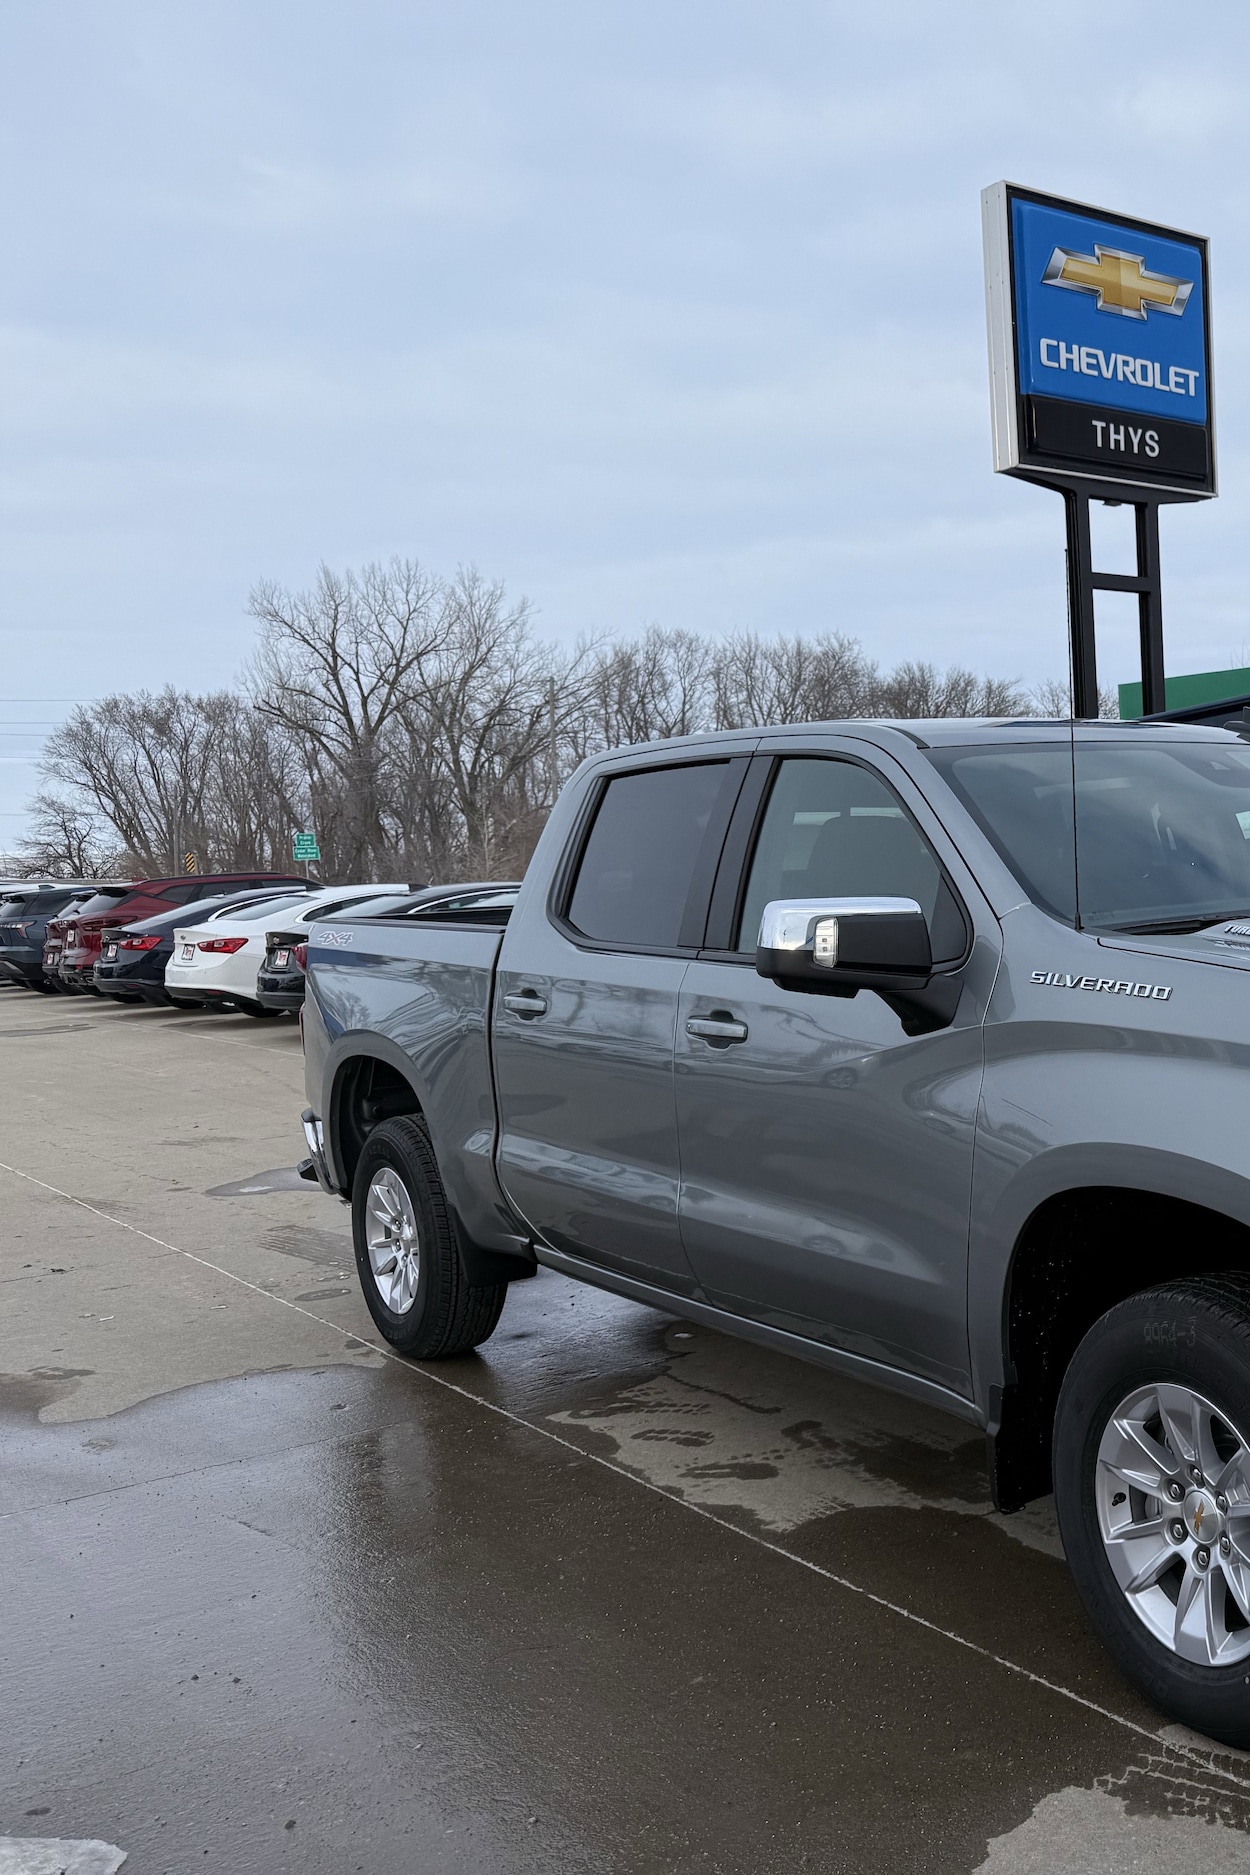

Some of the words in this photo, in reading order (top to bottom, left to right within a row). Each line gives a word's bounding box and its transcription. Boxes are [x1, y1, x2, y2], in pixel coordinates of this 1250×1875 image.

[1039, 337, 1200, 397] CHEVROLET
[1091, 419, 1160, 457] THYS
[1029, 970, 1173, 1001] SILVERADO
